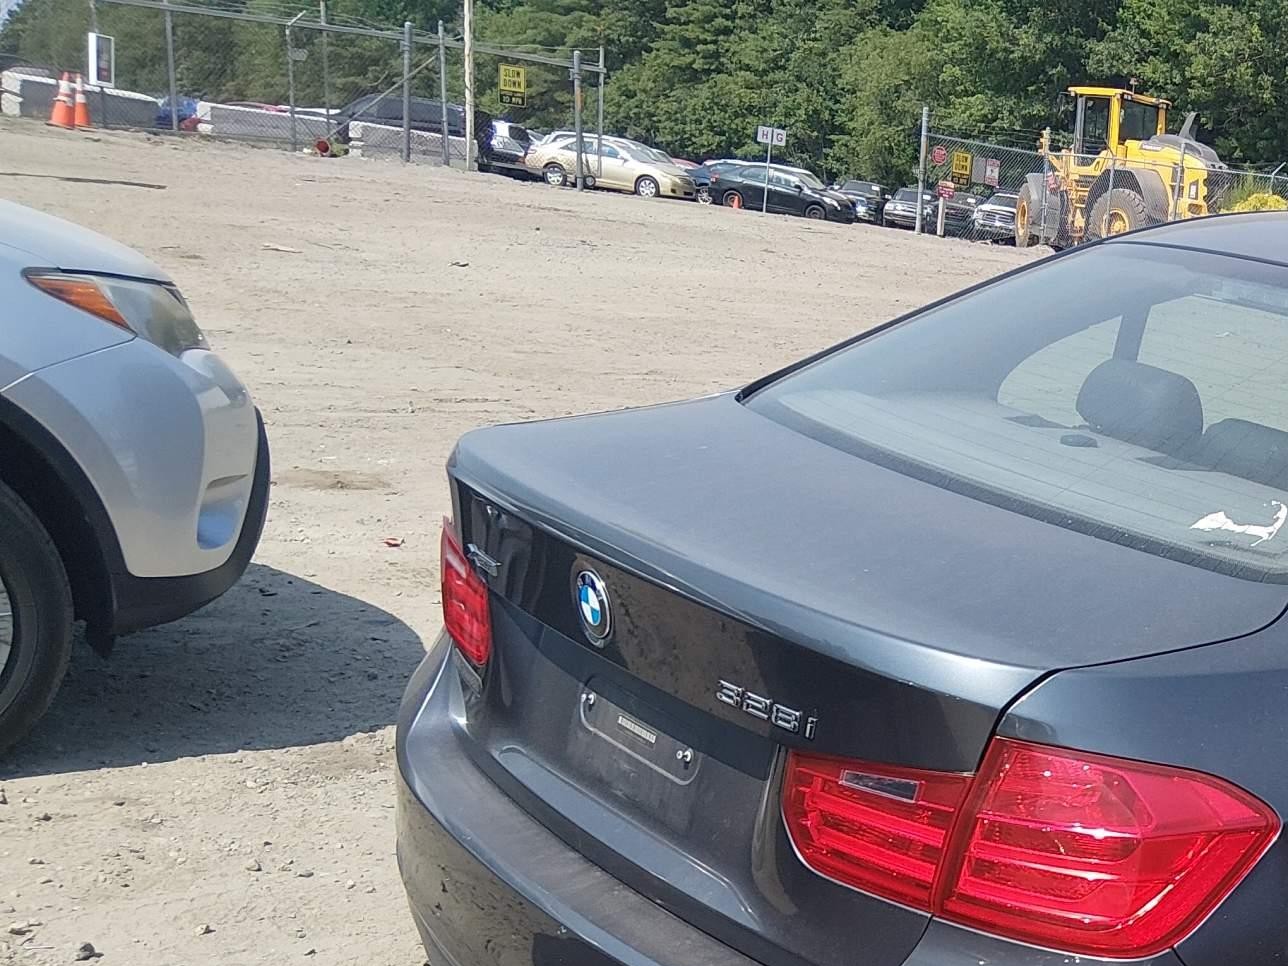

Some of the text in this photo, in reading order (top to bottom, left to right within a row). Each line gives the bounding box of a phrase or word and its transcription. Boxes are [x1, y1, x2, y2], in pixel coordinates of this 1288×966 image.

[503, 68, 521, 78] SLOW
[503, 78, 521, 89] DOWN
[762, 129, 769, 139] H
[777, 133, 783, 143] G
[716, 679, 818, 740] 328i
